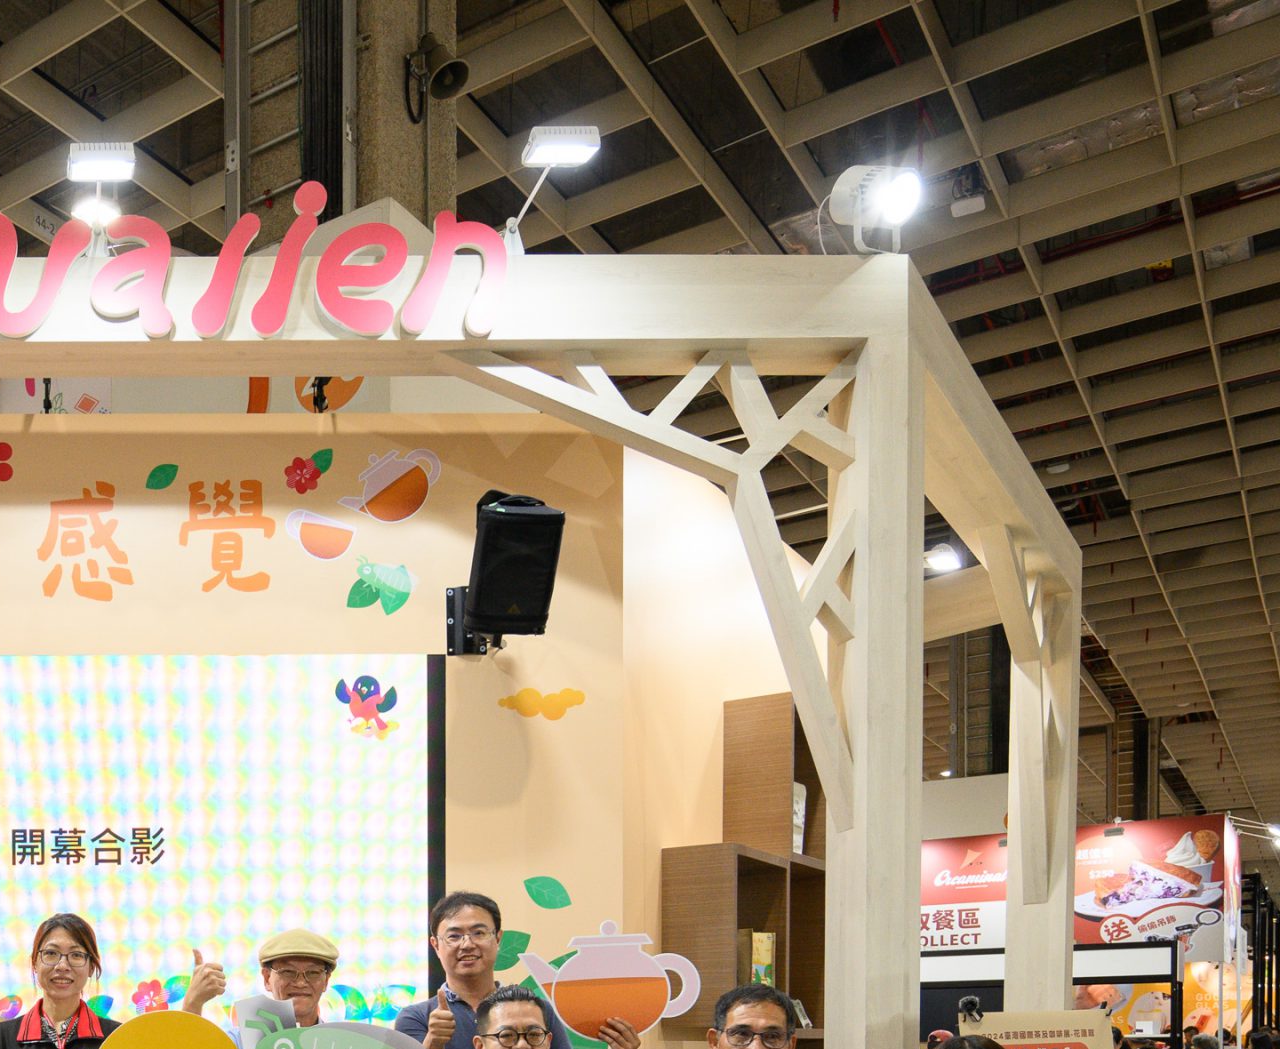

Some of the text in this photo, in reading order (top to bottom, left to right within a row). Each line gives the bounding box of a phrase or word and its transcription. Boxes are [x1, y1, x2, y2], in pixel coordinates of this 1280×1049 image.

[11, 827, 166, 866] 開幕合影
[920, 933, 981, 947] OLLECT
[1104, 919, 1132, 943] 送
